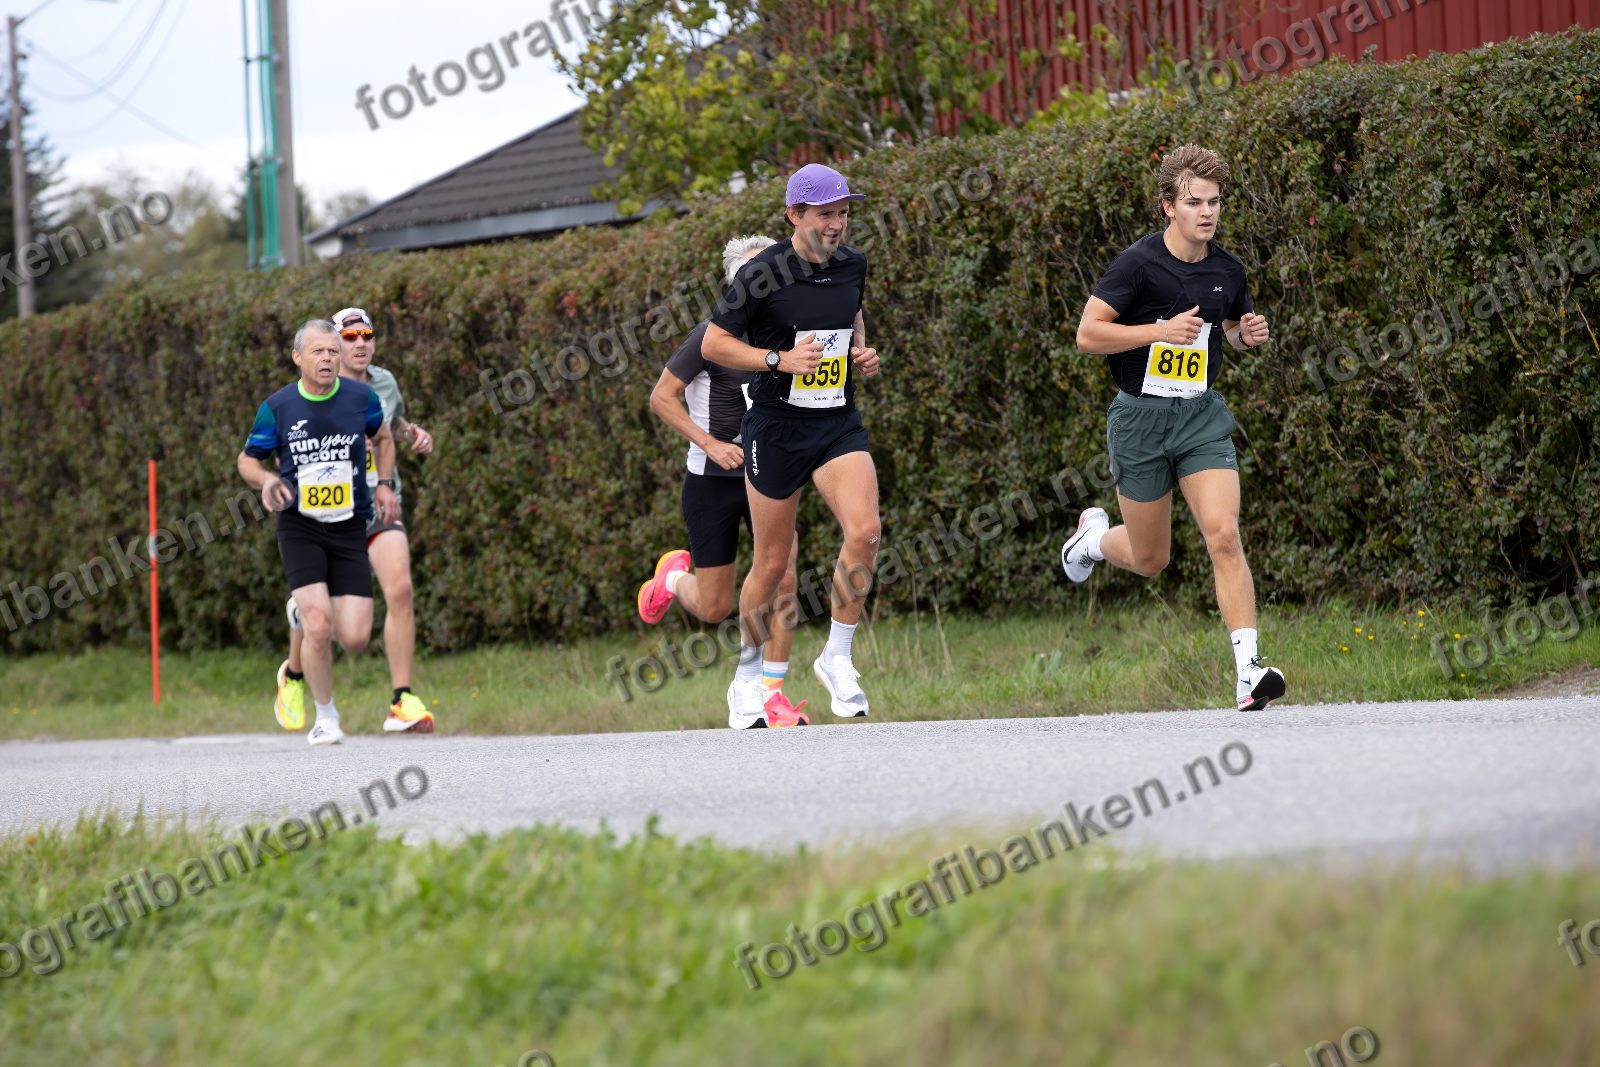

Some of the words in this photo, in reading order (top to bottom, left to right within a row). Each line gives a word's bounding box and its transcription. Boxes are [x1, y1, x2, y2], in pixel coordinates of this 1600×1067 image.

[1158, 349, 1200, 378] 816
[289, 438, 320, 453] run
[319, 433, 360, 452] your
[292, 445, 350, 466] record
[308, 485, 344, 506] 820
